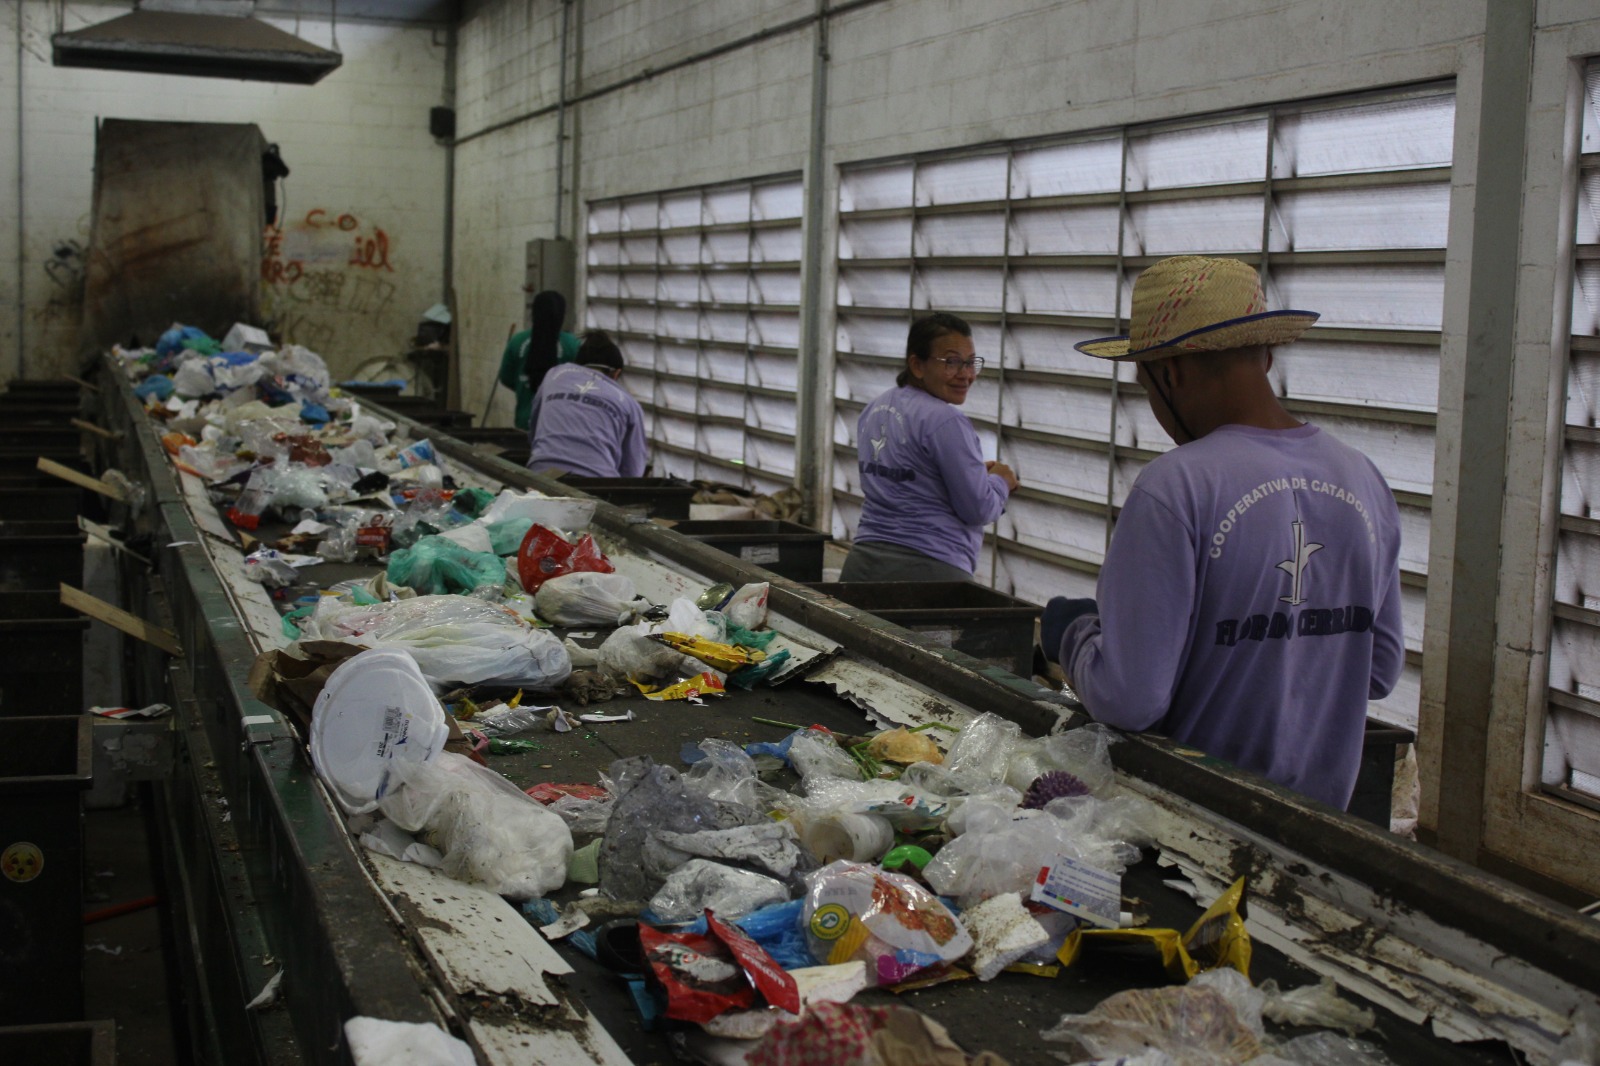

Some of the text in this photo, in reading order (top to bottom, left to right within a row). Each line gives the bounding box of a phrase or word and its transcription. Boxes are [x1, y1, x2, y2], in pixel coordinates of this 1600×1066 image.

[1209, 477, 1376, 559] COOPERATIVA DE CATADORES
